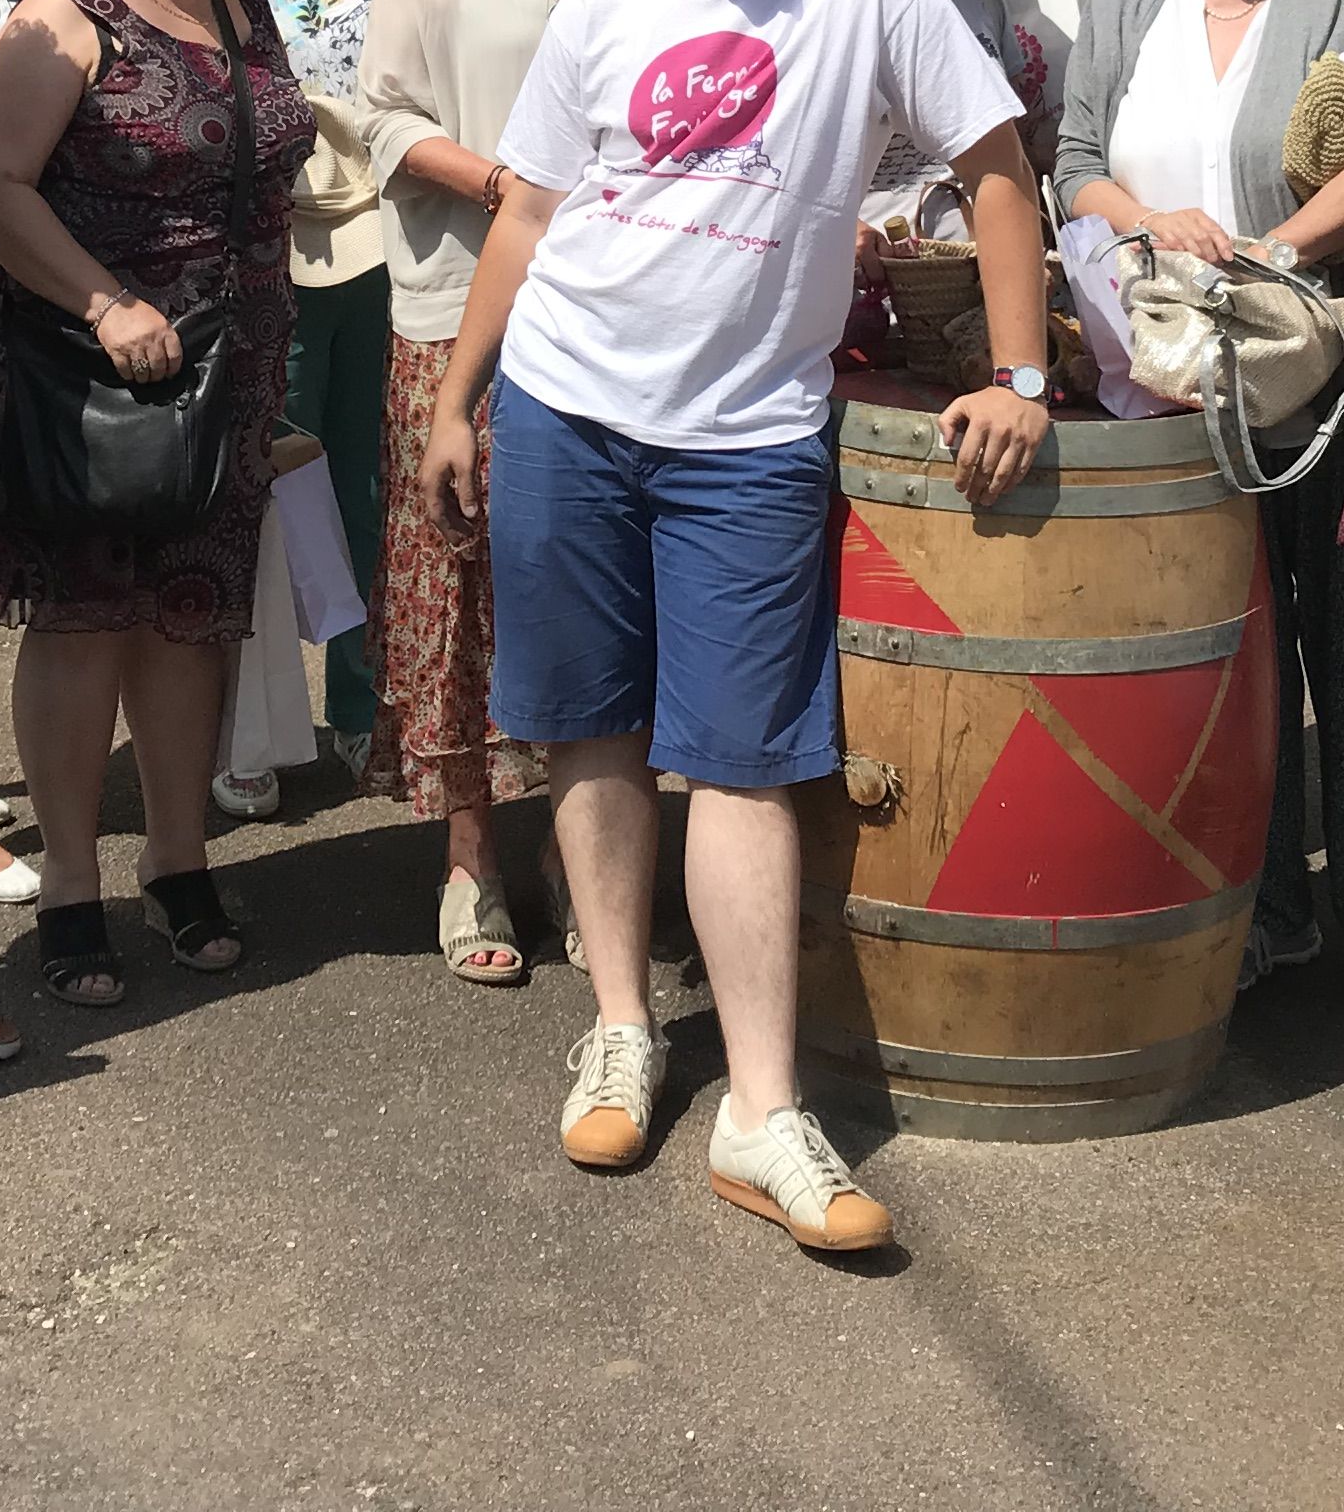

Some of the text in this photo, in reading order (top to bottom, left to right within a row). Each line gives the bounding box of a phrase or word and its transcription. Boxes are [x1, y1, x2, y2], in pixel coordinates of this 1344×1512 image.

[651, 72, 674, 105] la
[681, 218, 700, 235] de
[707, 223, 782, 255] Bourgogne
